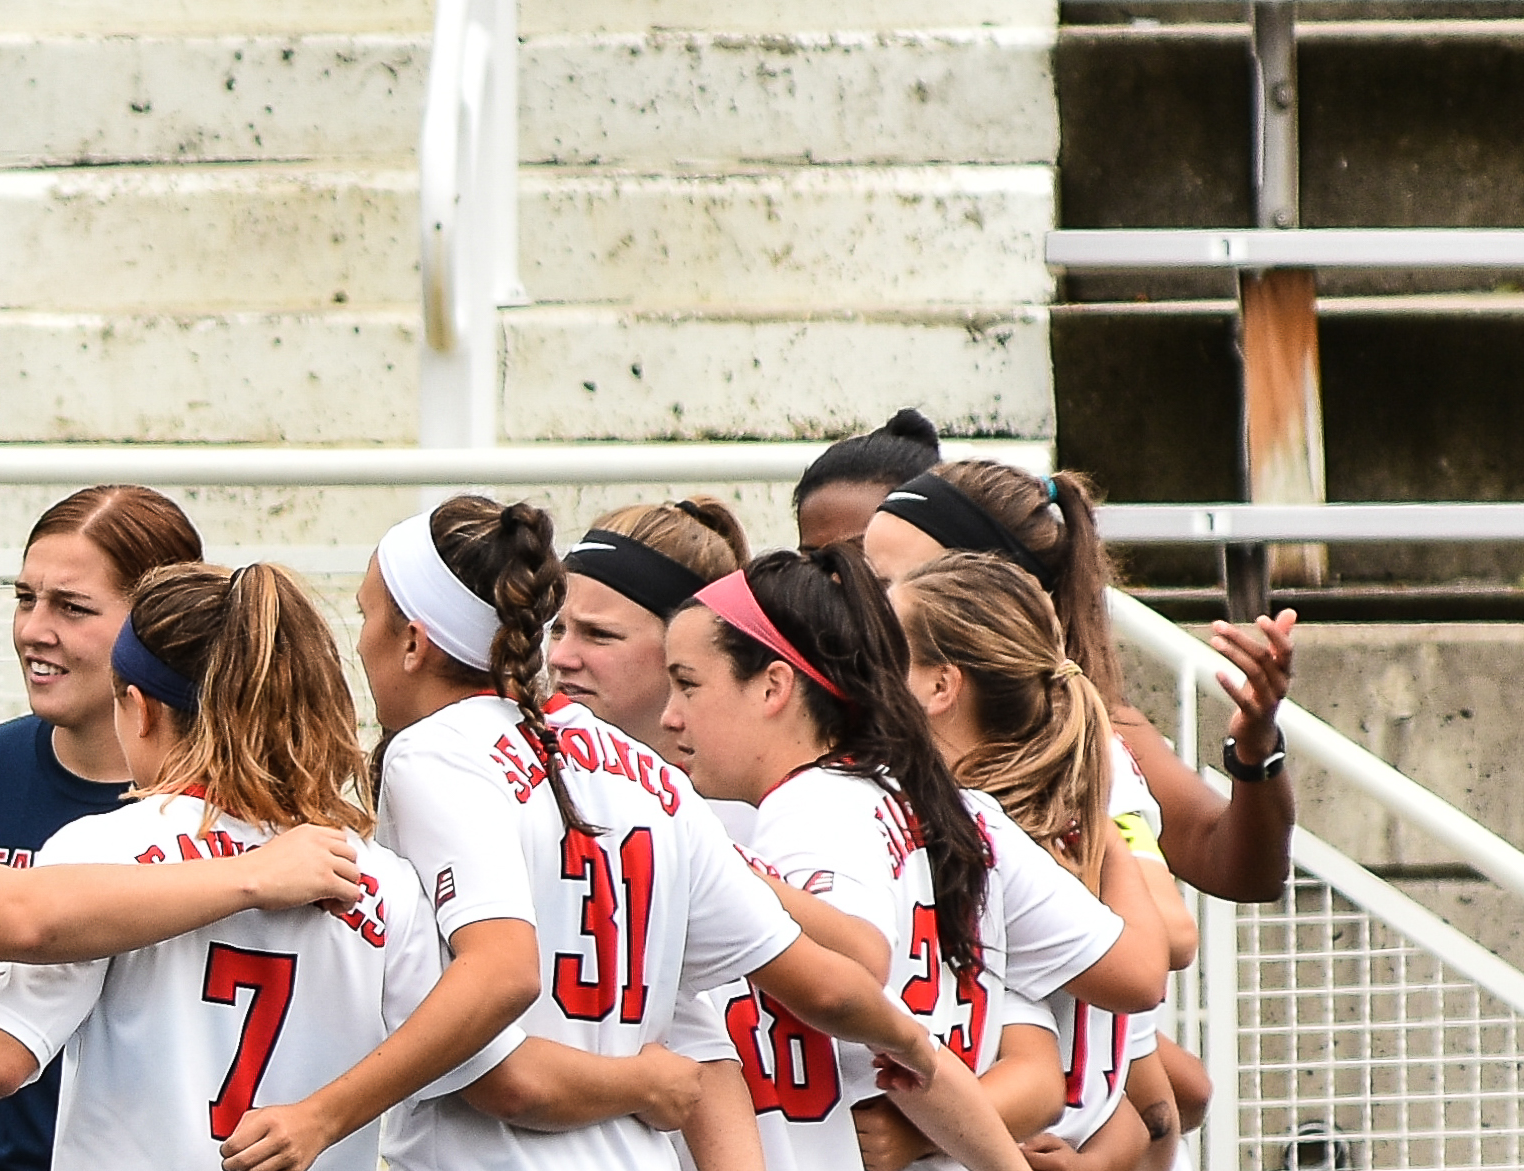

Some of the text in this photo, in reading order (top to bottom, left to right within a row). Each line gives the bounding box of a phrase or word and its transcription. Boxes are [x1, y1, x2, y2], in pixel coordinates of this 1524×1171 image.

[1221, 239, 1230, 257] 1
[1205, 513, 1214, 531] 1
[551, 825, 656, 1025] 31
[201, 939, 299, 1143] 7
